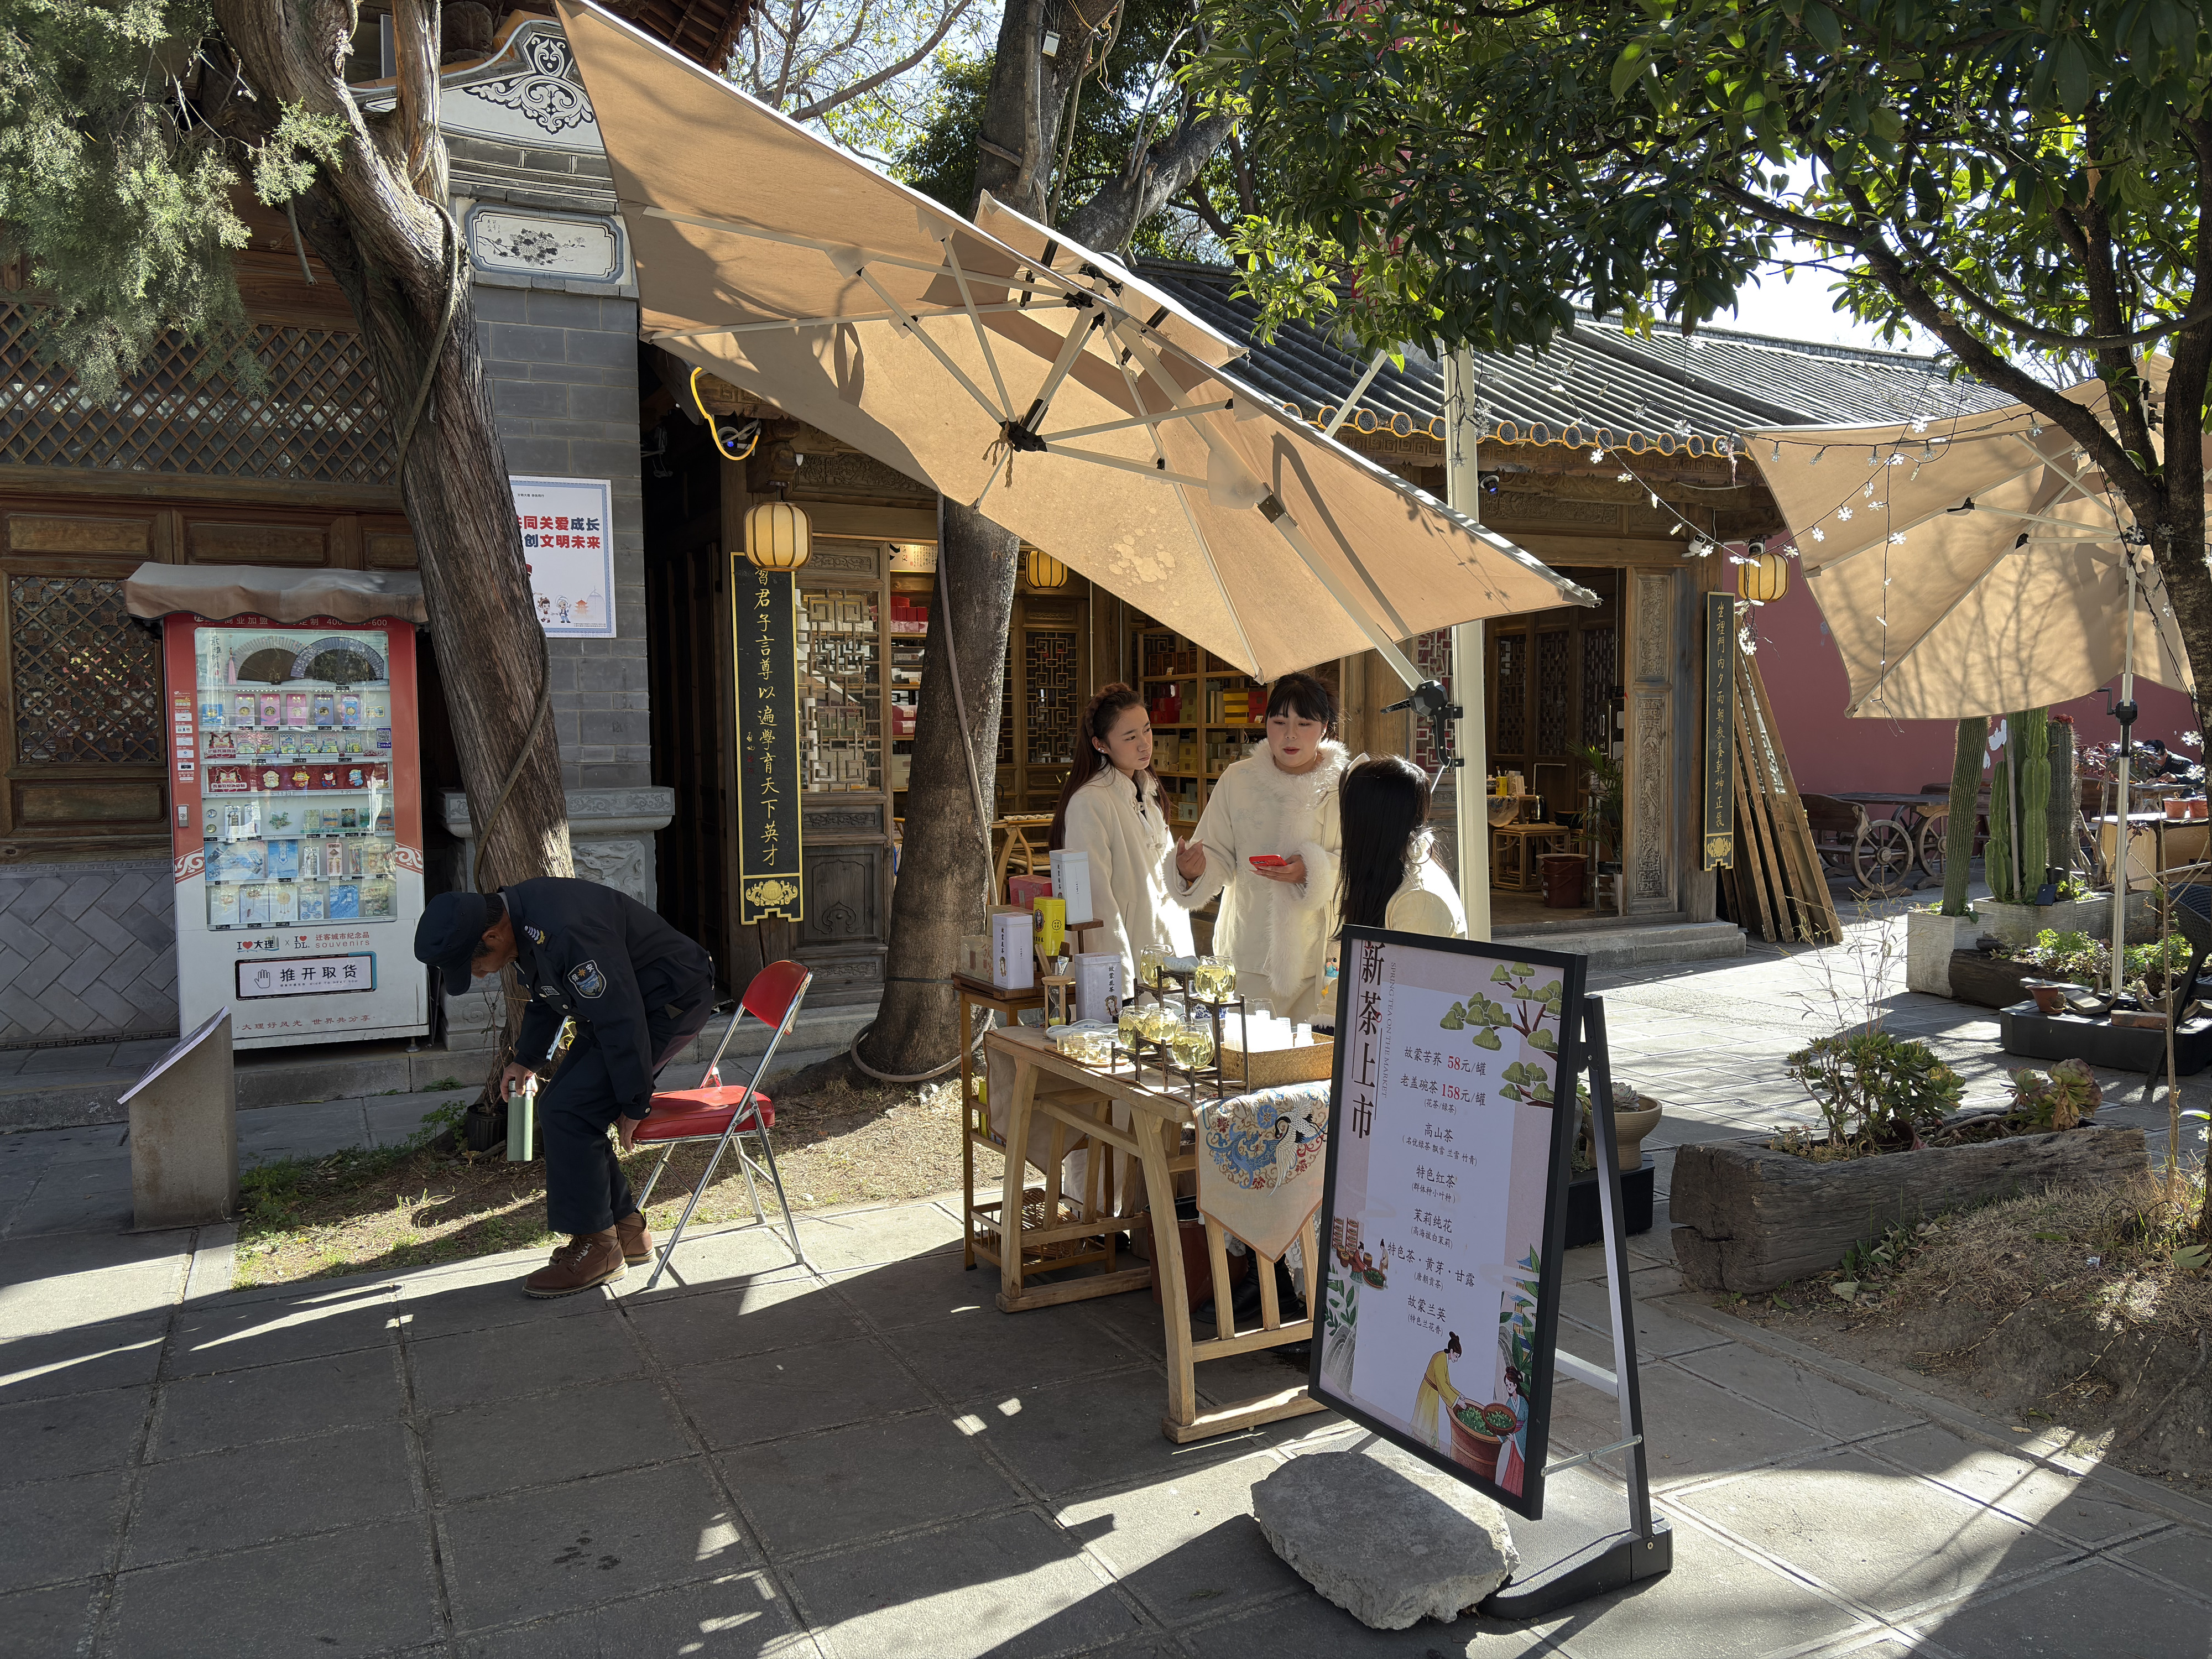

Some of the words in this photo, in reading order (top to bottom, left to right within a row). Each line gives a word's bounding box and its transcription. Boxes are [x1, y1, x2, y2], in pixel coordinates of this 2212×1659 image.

[524, 534, 601, 549] 创文明未来
[254, 940, 274, 949] 大理
[316, 932, 369, 941] 迁客城市纪念品
[316, 940, 370, 948] souvenirs
[280, 964, 357, 982] 推开取货
[241, 1020, 302, 1030] 大理好风光
[312, 1015, 371, 1025] 世界共分享
[1386, 1019, 1392, 1034] ON
[1353, 940, 1385, 1139] 新茶上市
[1404, 1046, 1442, 1067] 故蒙苦荞
[1447, 1055, 1486, 1076] 58元/罐
[1381, 1057, 1390, 1098] MARKET
[1400, 1073, 1438, 1094] 老盖碗茶
[1441, 1083, 1486, 1107] 158元/罐
[1425, 1123, 1454, 1143] 高山茶
[1447, 1149, 1460, 1160] 兰雪
[1416, 1165, 1455, 1188] 特色红茶
[1413, 1208, 1453, 1233] 茉莉纯花
[1407, 1295, 1447, 1323] 故蒙兰英
